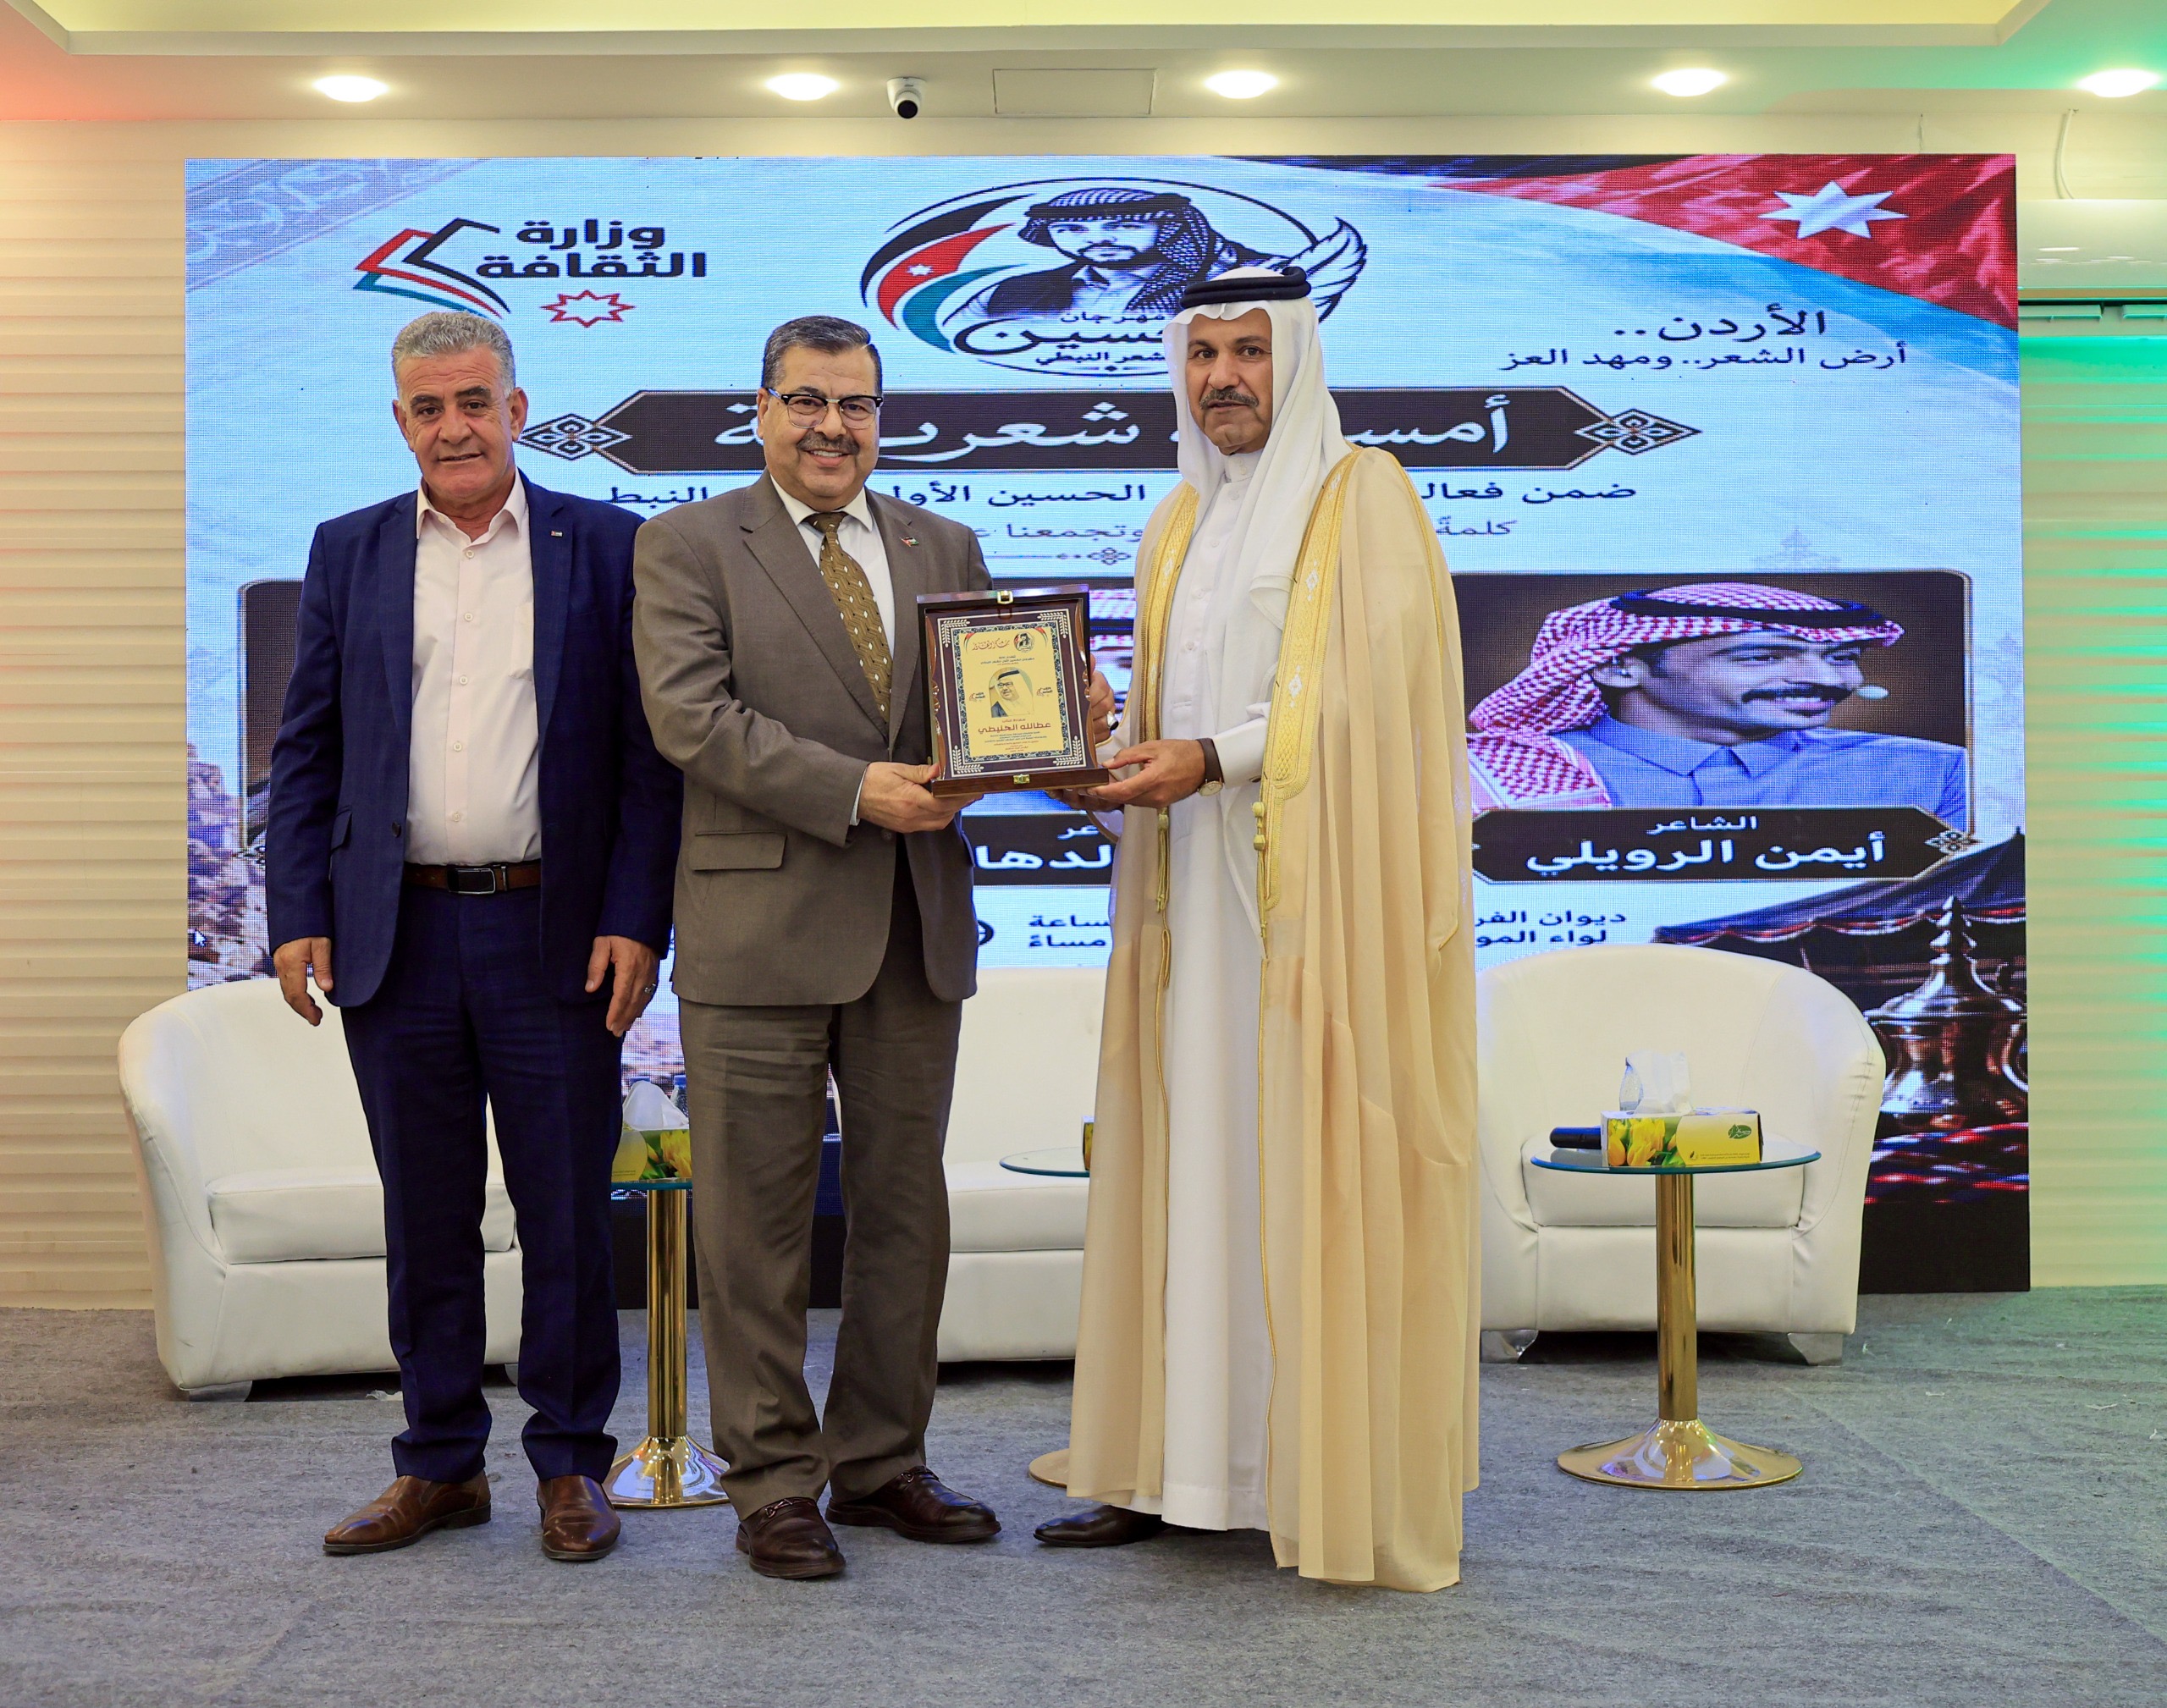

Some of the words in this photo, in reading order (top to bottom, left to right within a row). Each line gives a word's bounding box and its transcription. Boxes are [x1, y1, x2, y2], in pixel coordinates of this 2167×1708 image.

[516, 219, 664, 250] وزارة
[476, 252, 707, 278] الثقافة
[1061, 311, 1166, 324] مهرجان
[954, 317, 1163, 355] سين
[1035, 352, 1109, 366] النبطي
[1114, 352, 1166, 364] شعر
[1501, 349, 1569, 370] العز
[1819, 341, 1906, 369] أرض
[604, 486, 709, 509] النبط
[988, 484, 1145, 506] الحسين
[1421, 482, 1503, 499] فعال
[1521, 482, 1637, 504] ضمن
[1019, 722, 1051, 730] عطالله
[1646, 816, 1757, 835] الشاعر
[1525, 838, 1734, 878] الرويلي
[1754, 831, 1886, 870] أيمن
[1028, 914, 1111, 928] ساعة
[1475, 911, 1527, 928] الفر
[1538, 910, 1627, 927] ديوان
[1475, 930, 1536, 948] المو
[1549, 929, 1607, 947] لواء
